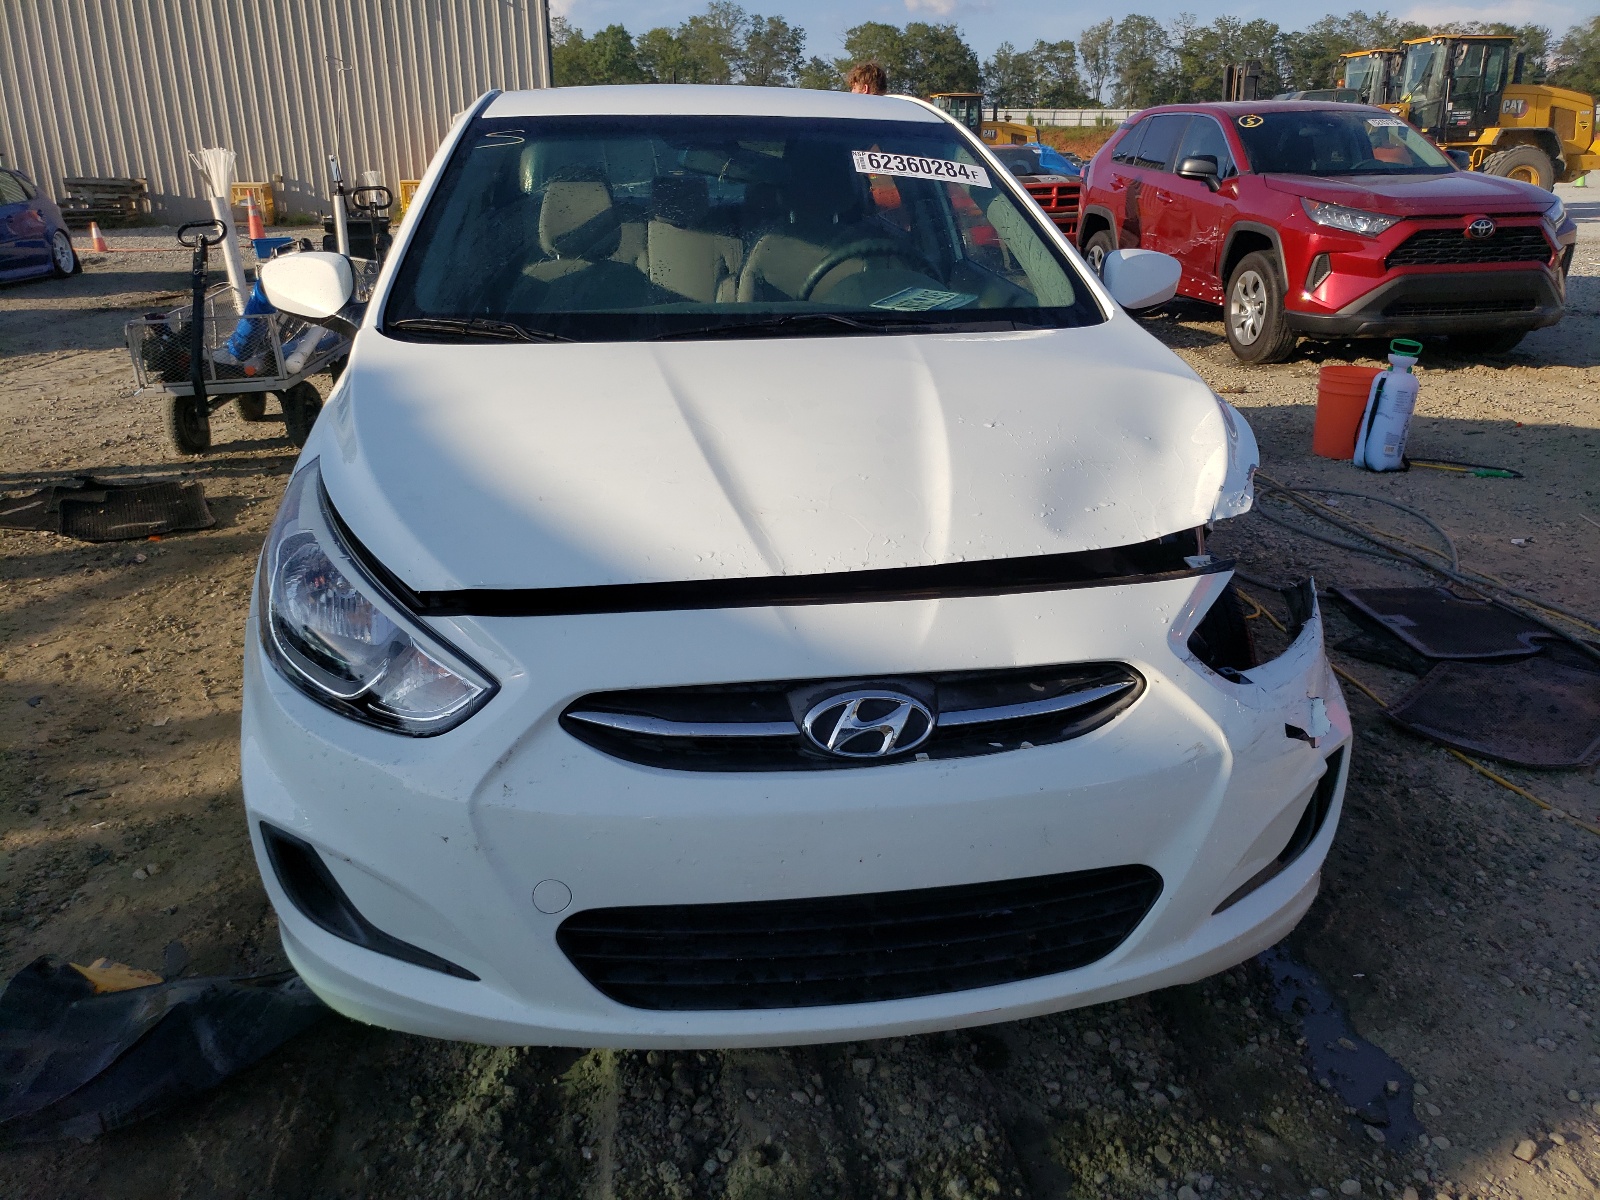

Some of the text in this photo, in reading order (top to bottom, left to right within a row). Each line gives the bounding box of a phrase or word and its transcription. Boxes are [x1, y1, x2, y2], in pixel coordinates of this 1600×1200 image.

[1502, 99, 1523, 114] CAT
[982, 129, 996, 138] CAT
[867, 153, 970, 179] 62360284
